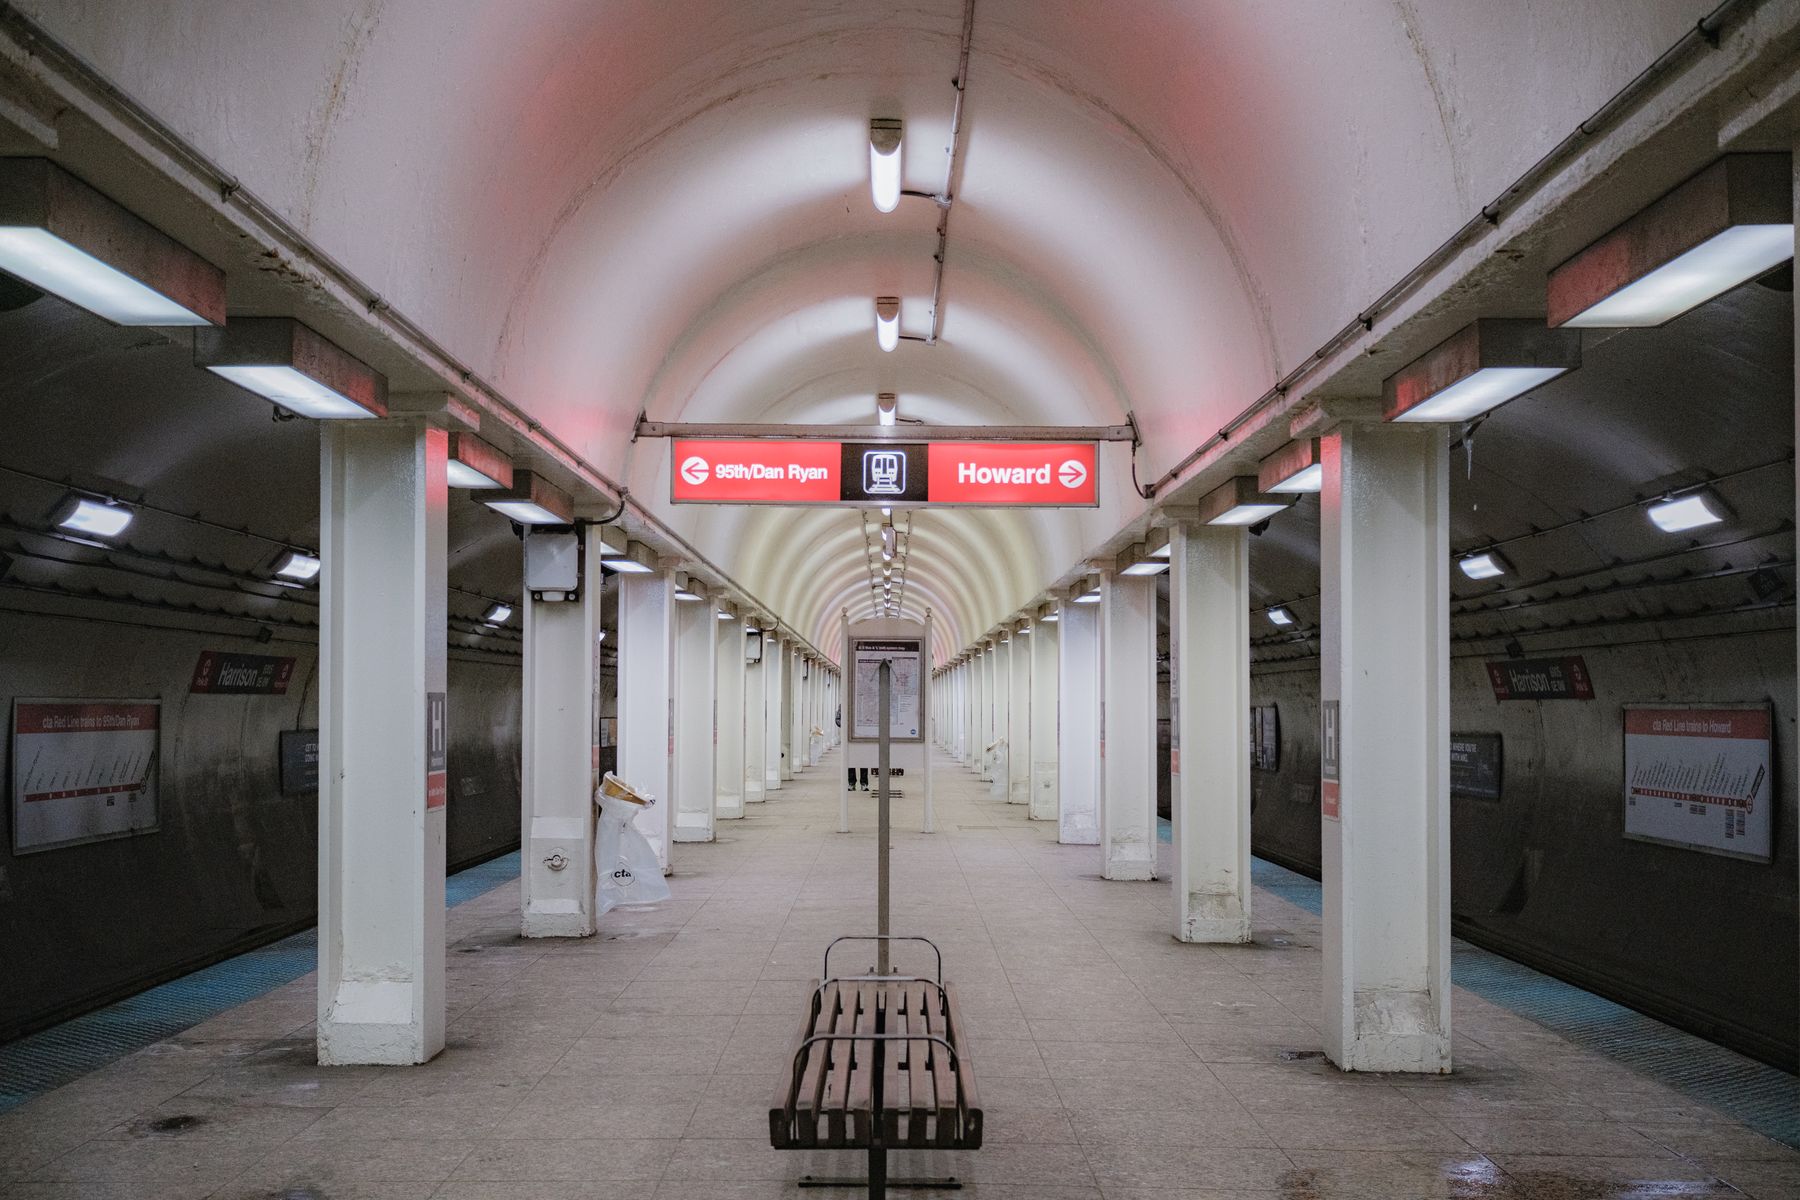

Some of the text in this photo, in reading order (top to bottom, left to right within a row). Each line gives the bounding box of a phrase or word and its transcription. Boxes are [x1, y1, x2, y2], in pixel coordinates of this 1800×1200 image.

[715, 464, 828, 484] 95th/Dan Ryan
[958, 463, 1051, 484] Howard
[218, 662, 258, 688] Harrison
[1508, 669, 1551, 692] Harrison
[54, 715, 66, 728] Red
[67, 715, 80, 728] Line
[432, 701, 442, 752] H
[1662, 719, 1673, 732] Red
[1673, 719, 1686, 732] Line
[1686, 720, 1702, 733] trains
[1702, 720, 1709, 733] to
[1709, 720, 1732, 734] Howard
[1325, 708, 1335, 760] H
[614, 868, 632, 878] cta
